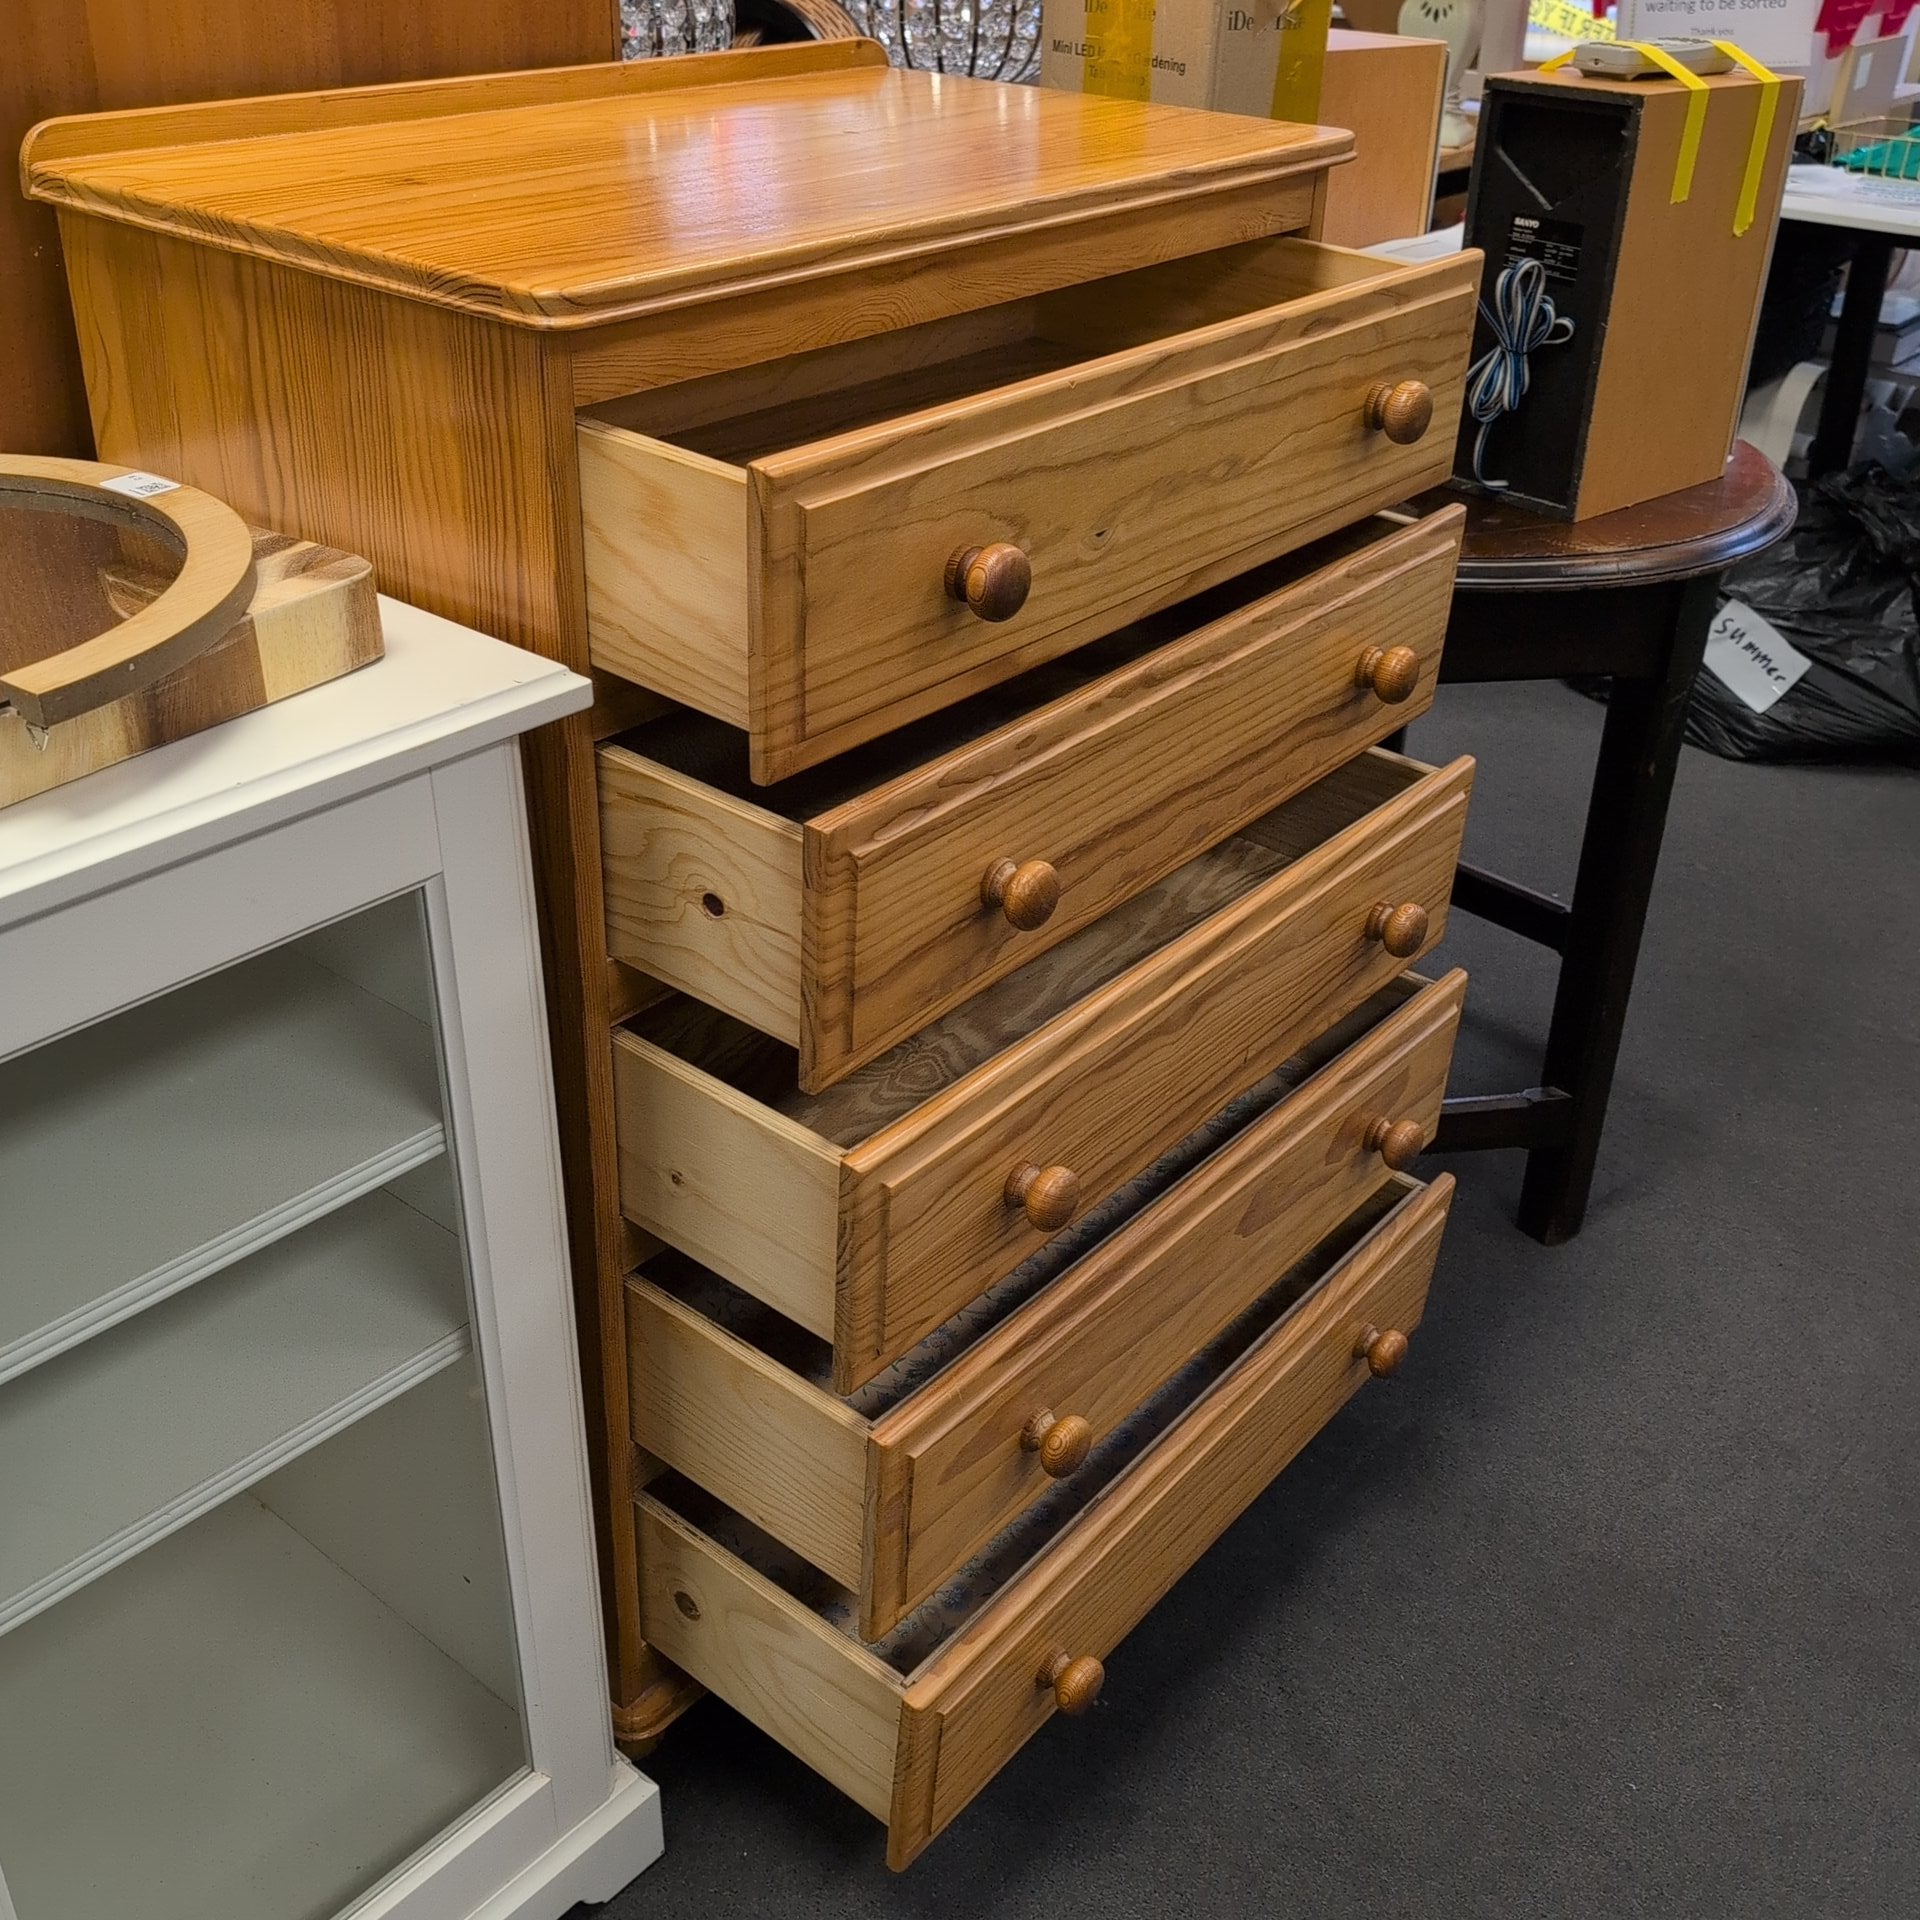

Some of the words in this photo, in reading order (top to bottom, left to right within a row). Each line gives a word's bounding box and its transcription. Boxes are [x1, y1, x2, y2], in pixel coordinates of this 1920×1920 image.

[1645, 0, 1696, 14] waiting
[1699, 0, 1715, 11] to
[1718, 0, 1736, 10] be
[1739, 0, 1787, 10] sorted
[1052, 39, 1073, 55] Mini
[1074, 42, 1096, 58] LED
[1514, 217, 1540, 229] SANYO
[1714, 617, 1787, 682] Summer
